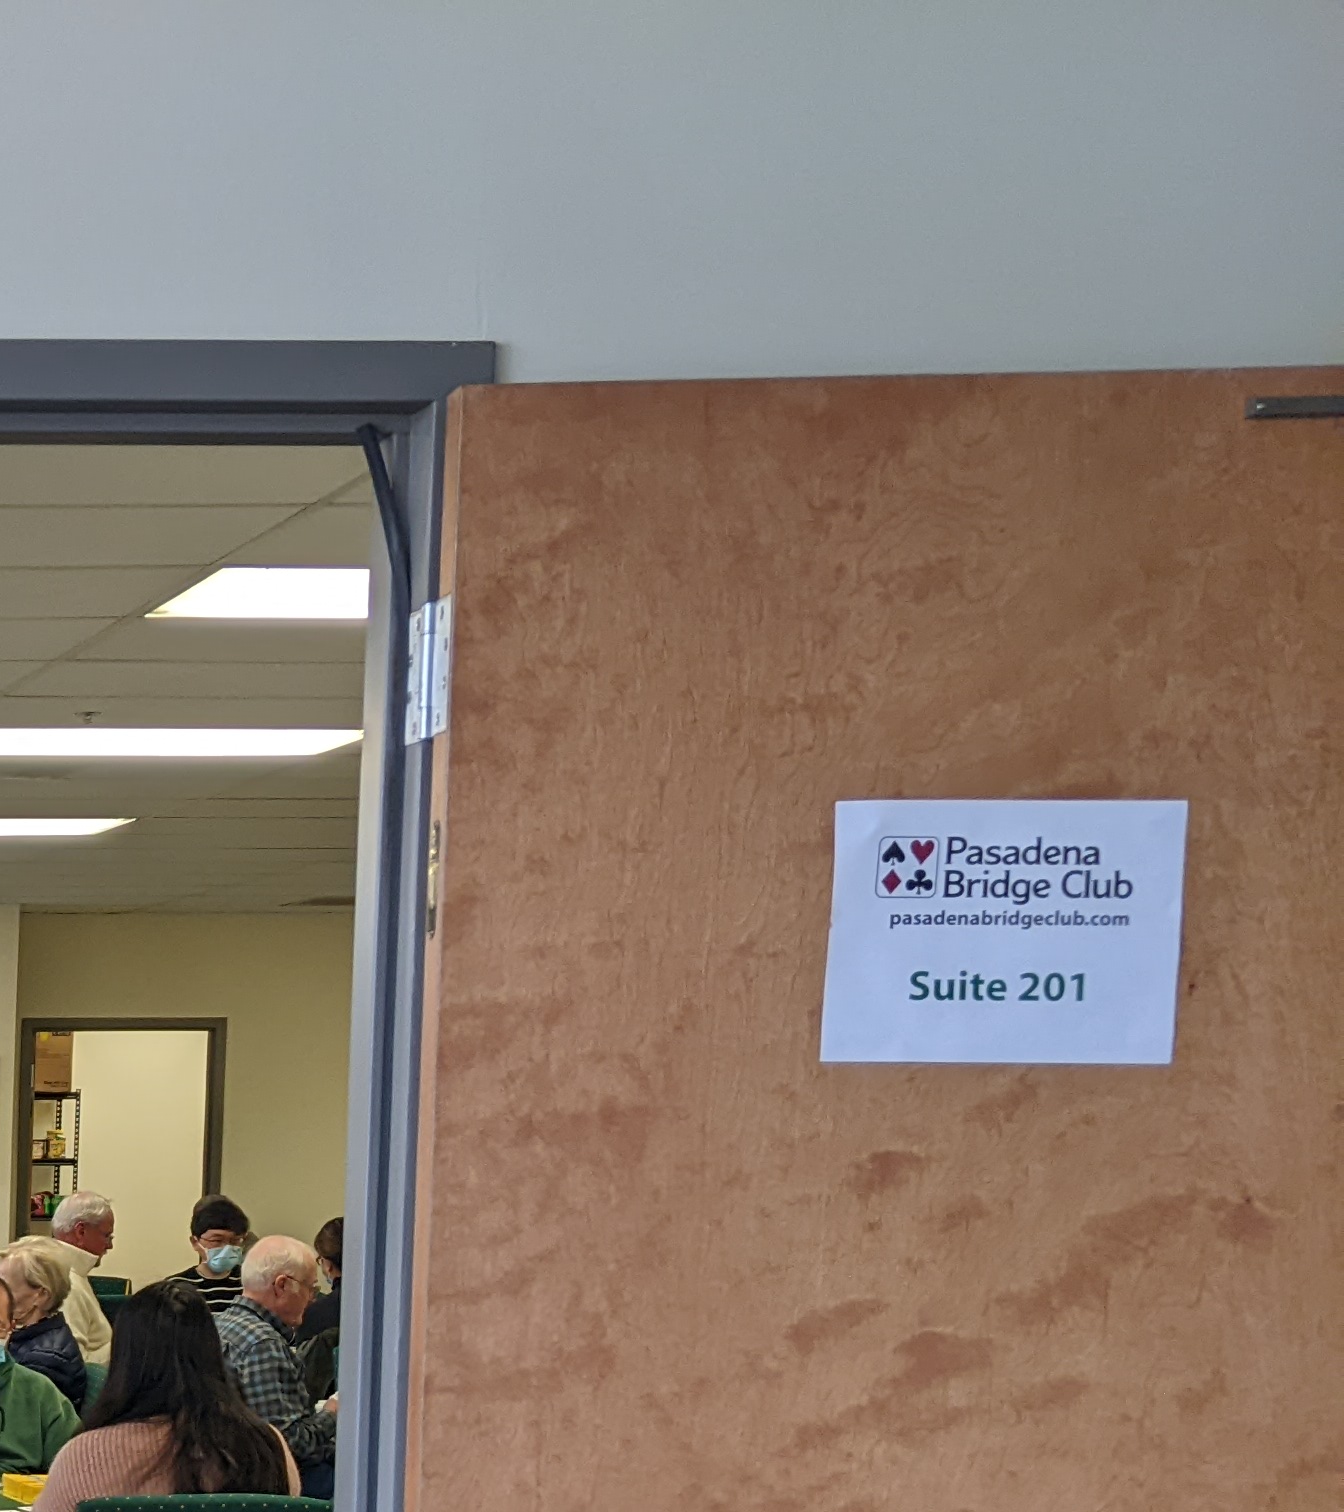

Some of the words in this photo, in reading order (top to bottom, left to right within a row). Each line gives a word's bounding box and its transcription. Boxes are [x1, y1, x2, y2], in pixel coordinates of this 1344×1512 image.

[945, 835, 1101, 866] Pasadena
[942, 869, 1051, 905] Bridge
[1062, 869, 1133, 900] Club
[888, 910, 1130, 929] pasadenabridgeclub.com
[908, 970, 1008, 1001] Suite
[1018, 973, 1085, 1002] 201
